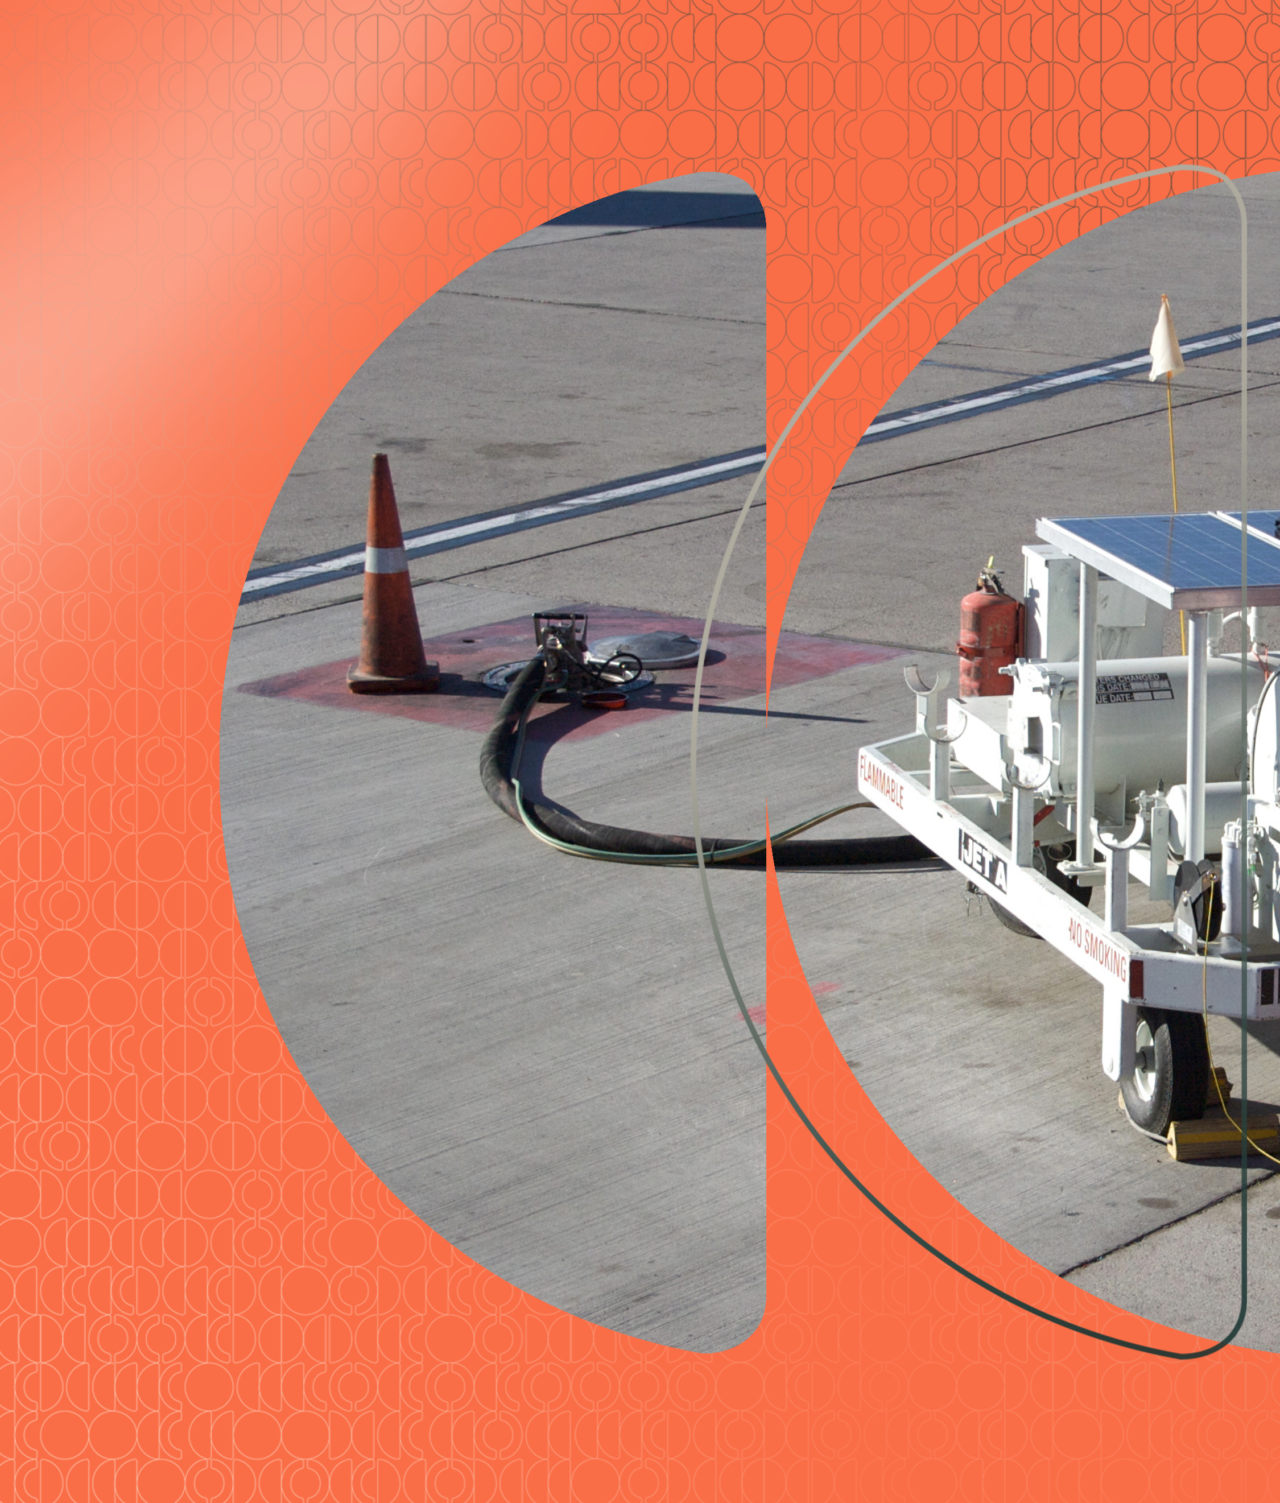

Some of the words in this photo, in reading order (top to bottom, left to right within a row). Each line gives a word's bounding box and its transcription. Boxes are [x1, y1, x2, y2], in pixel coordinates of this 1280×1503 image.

[1096, 684, 1106, 692] IS
[1107, 683, 1131, 691] DATE:
[1119, 674, 1159, 682] CHANGED
[1096, 694, 1108, 703] UE
[1110, 693, 1133, 702] DATE:
[860, 755, 904, 810] FLAMMABLE
[963, 839, 994, 878] JET
[994, 859, 1008, 892] A
[1068, 917, 1082, 948] NO
[1084, 929, 1127, 983] SMOKING
